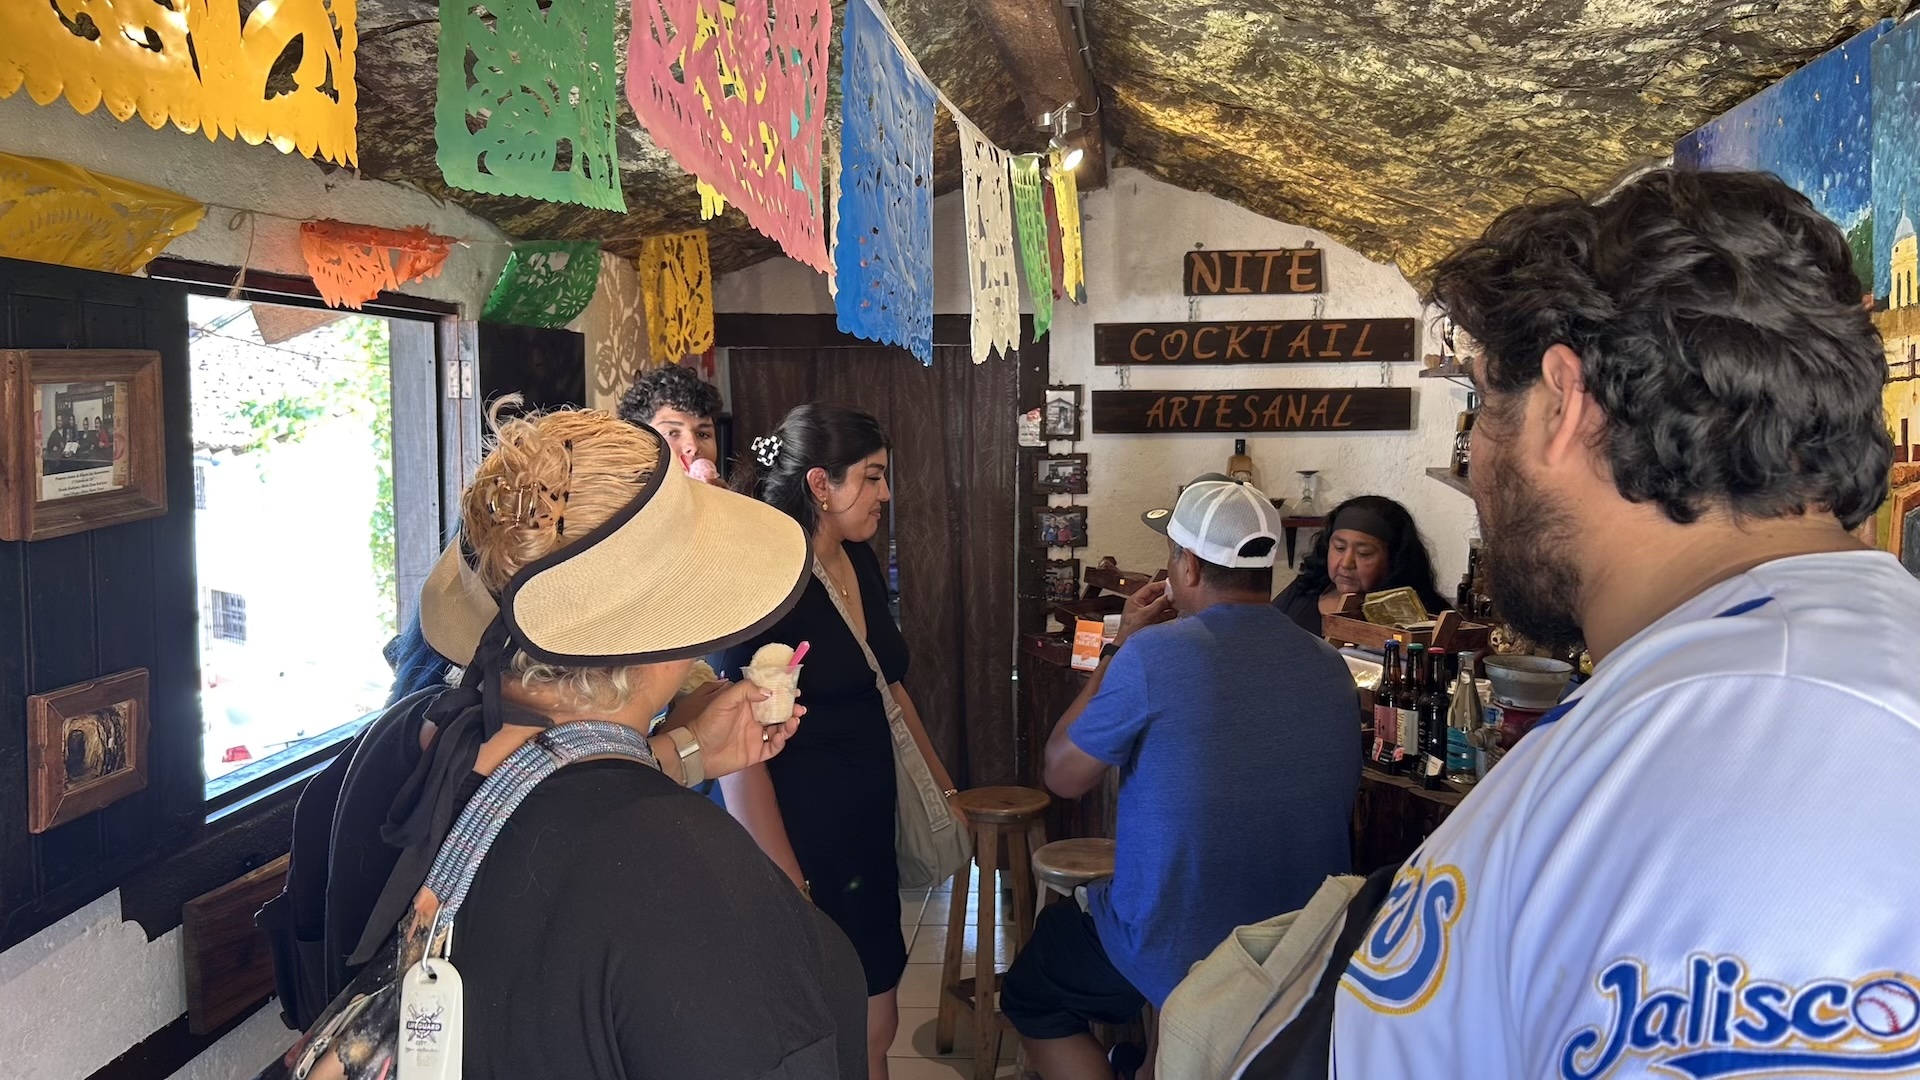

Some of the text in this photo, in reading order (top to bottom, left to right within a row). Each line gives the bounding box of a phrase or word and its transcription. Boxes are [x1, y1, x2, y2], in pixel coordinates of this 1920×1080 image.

[1191, 250, 1318, 295] NITE
[1129, 323, 1375, 363] COCKTAIL
[1146, 394, 1354, 429] ARTESANAL
[407, 1022, 441, 1030] LIFGUARD
[1559, 955, 1919, 1080] Jalisco
